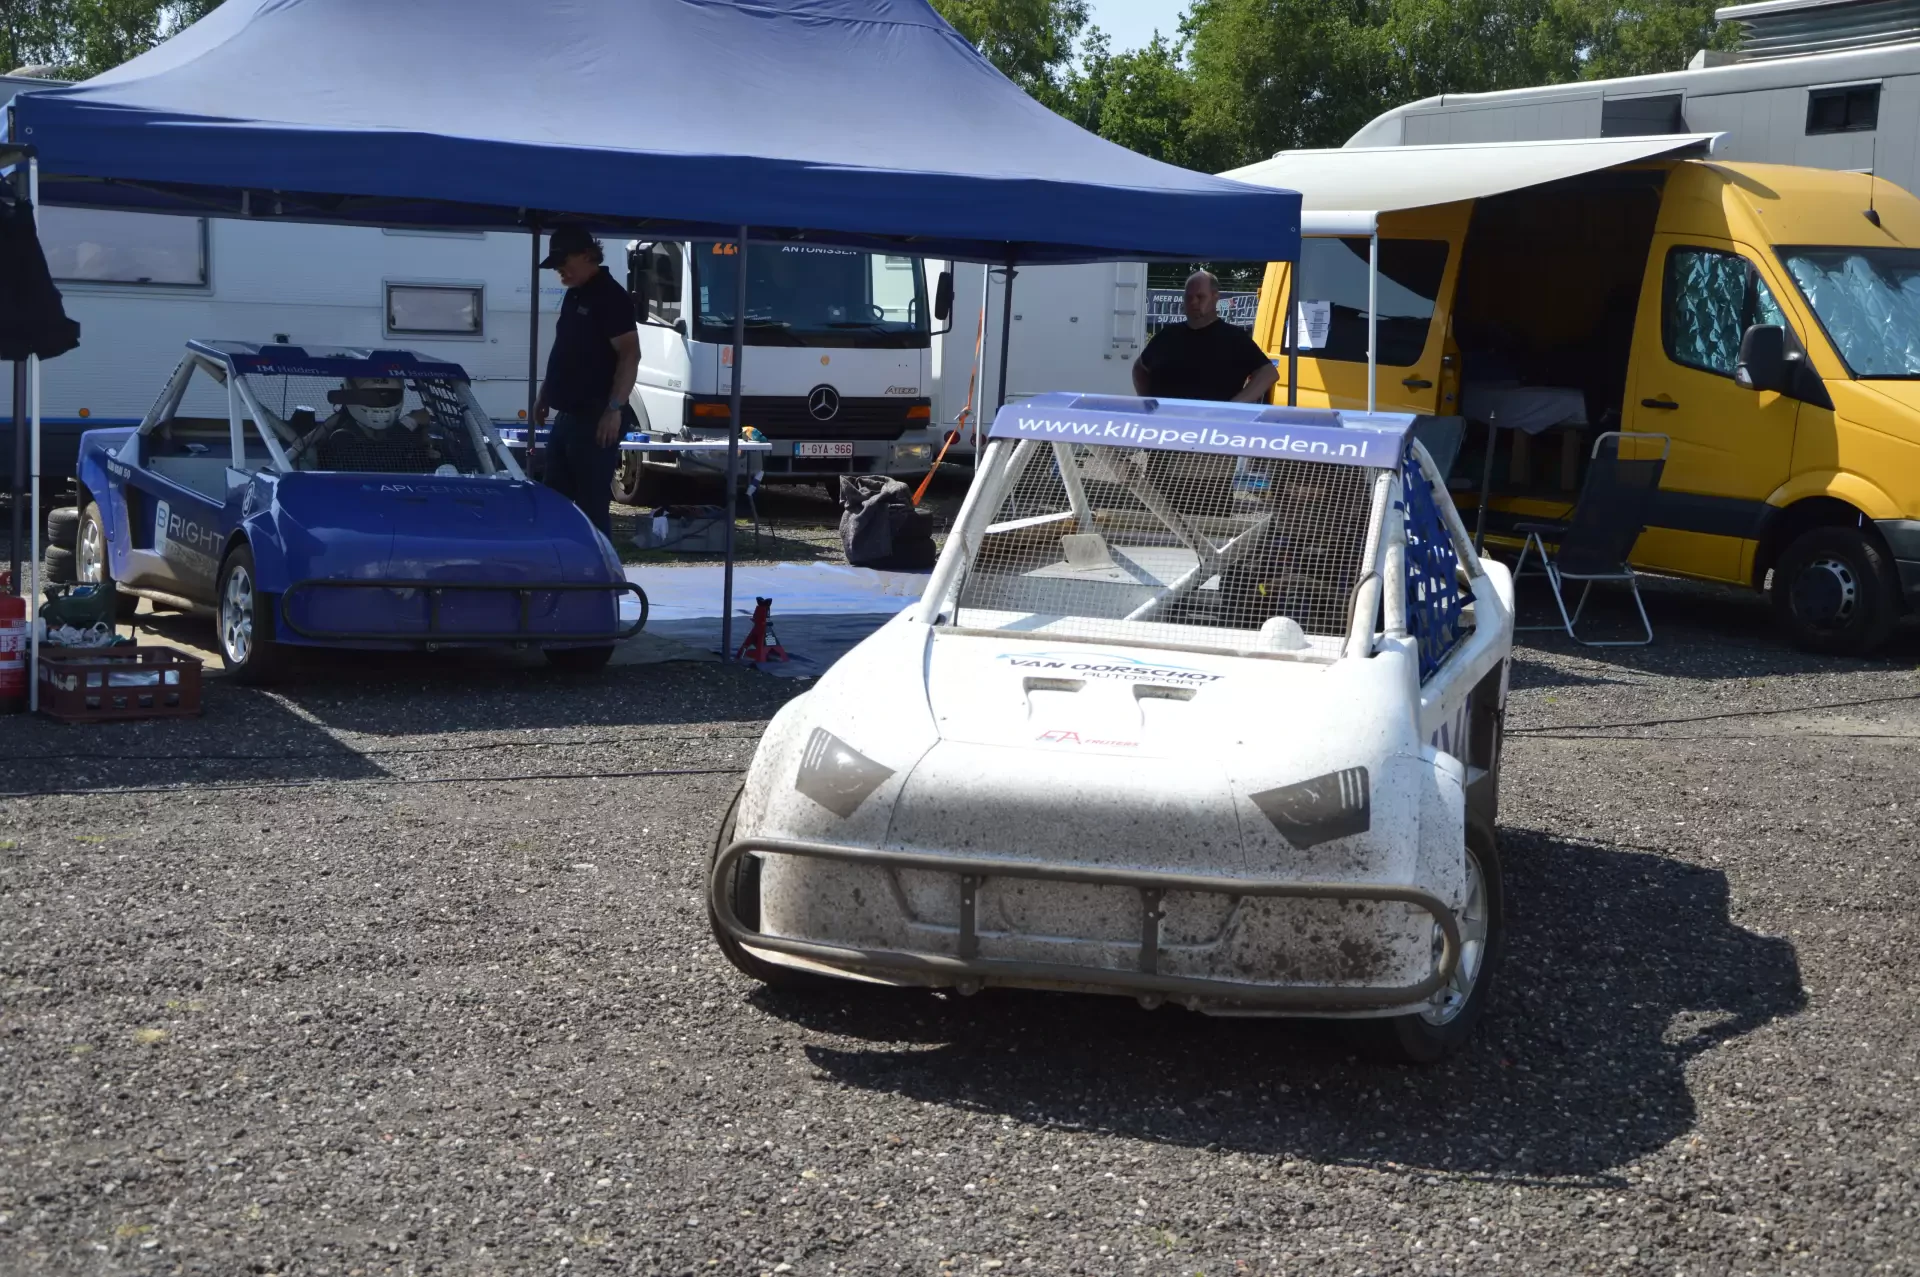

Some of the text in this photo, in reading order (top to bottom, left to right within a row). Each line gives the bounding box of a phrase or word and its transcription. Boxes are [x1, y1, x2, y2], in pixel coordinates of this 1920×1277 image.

[1018, 416, 1369, 459] www.klippelbanden.nl
[380, 484, 504, 496] API CENTER
[157, 507, 225, 554] BRIGHT
[1009, 658, 1225, 682] VAN OORSCHOT
[1083, 671, 1208, 687] AUTOSPORT
